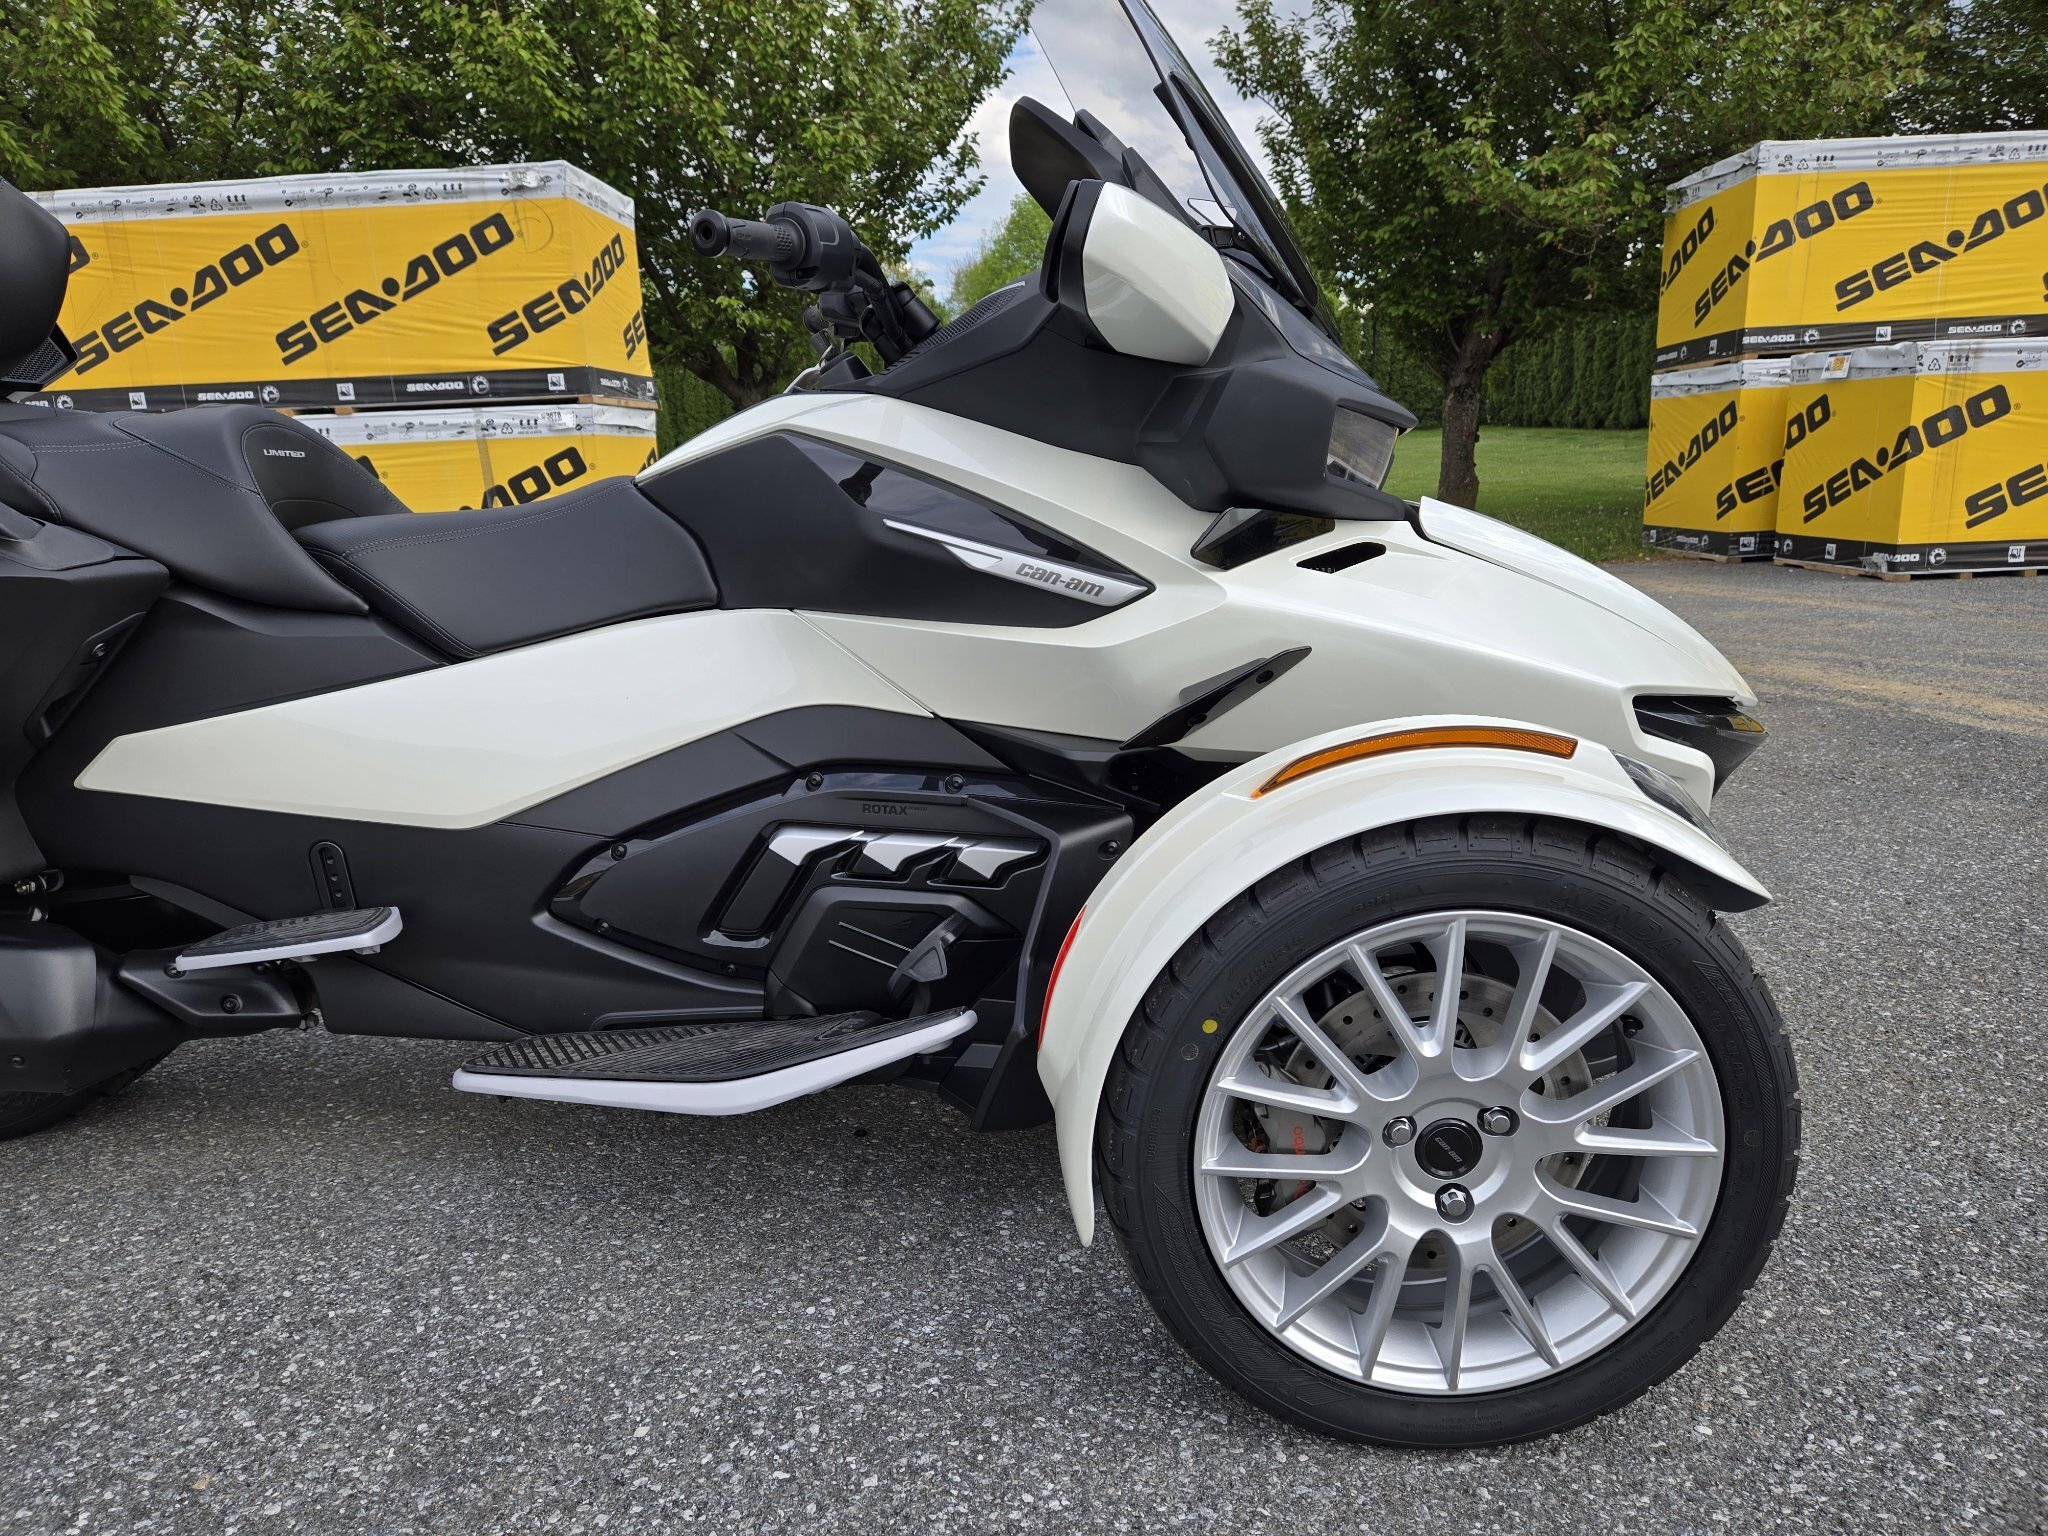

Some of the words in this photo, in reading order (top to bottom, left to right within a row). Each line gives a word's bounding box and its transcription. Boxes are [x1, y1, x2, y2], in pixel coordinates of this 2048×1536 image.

[263, 449, 306, 458] LIMITED
[1015, 562, 1105, 597] can-am
[862, 803, 908, 816] ROTAX
[1434, 1136, 1463, 1163] can-am
